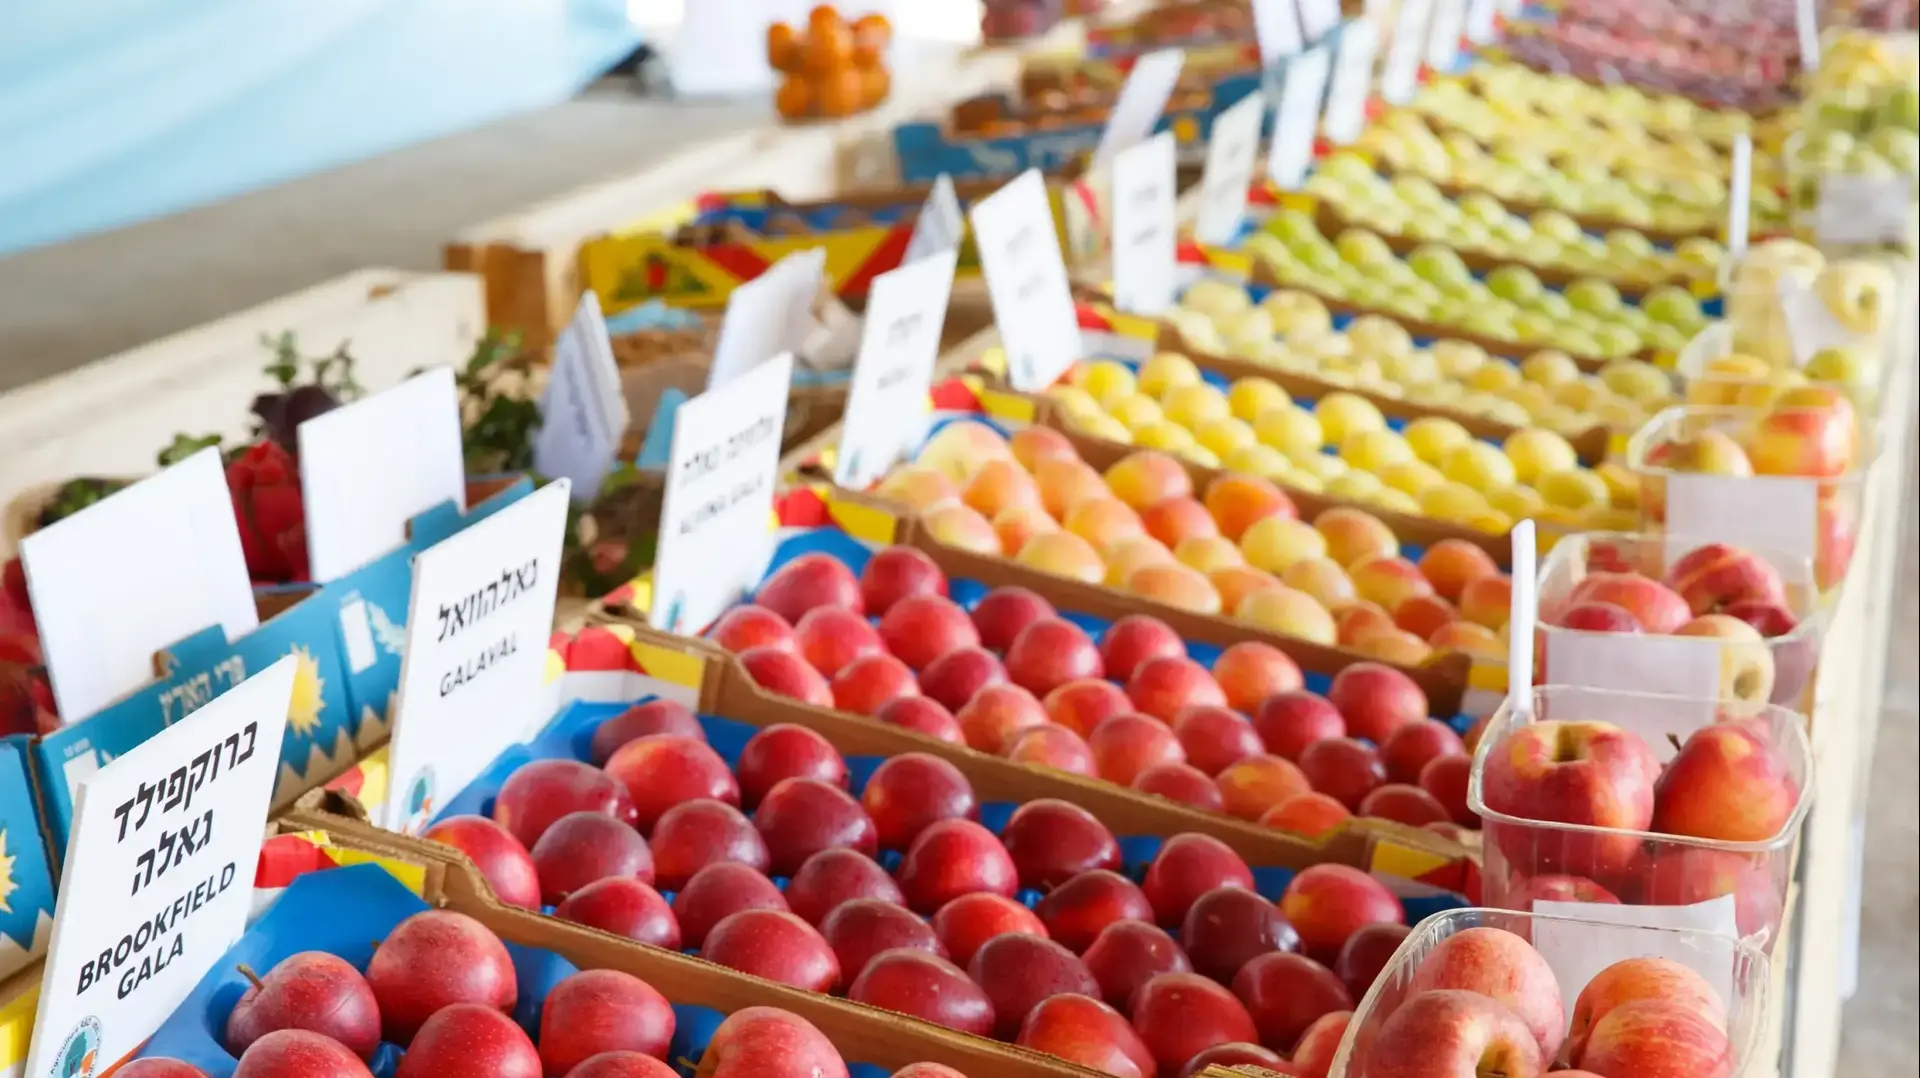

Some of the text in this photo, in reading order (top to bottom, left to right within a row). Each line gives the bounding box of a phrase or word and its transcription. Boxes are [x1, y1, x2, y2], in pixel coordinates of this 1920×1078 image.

[437, 558, 538, 643] גאלהוואל
[440, 632, 518, 698] GALAVAL
[113, 721, 258, 844] ברוקפילד
[131, 809, 213, 897] גאלה
[76, 861, 236, 996] BROOKFIELD
[117, 932, 184, 1000] GALA
